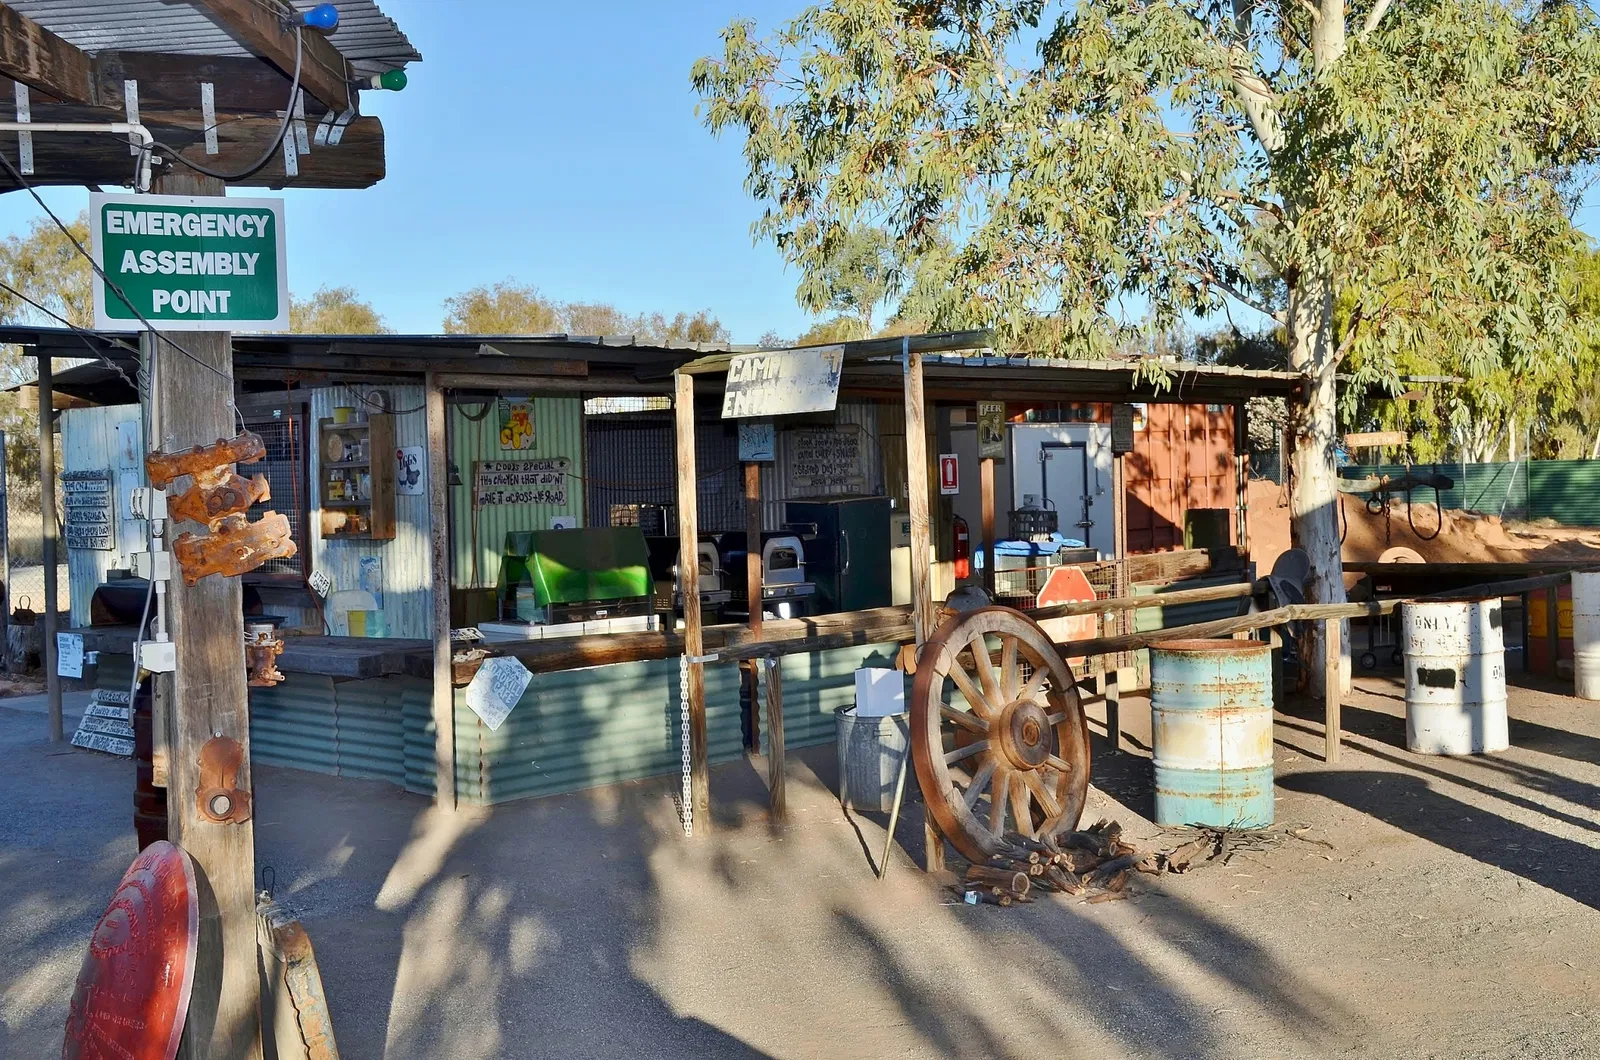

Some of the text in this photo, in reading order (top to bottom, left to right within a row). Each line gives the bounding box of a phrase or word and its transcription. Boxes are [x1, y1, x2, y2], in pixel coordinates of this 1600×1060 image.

[106, 210, 270, 239] EMERGENCY
[120, 249, 260, 276] ASSEMBLY
[152, 289, 232, 315] POINT
[980, 404, 1002, 417] BEER
[314, 570, 330, 587] STAFF
[486, 660, 520, 698] ROADKILL
[493, 681, 514, 704] CAFE
